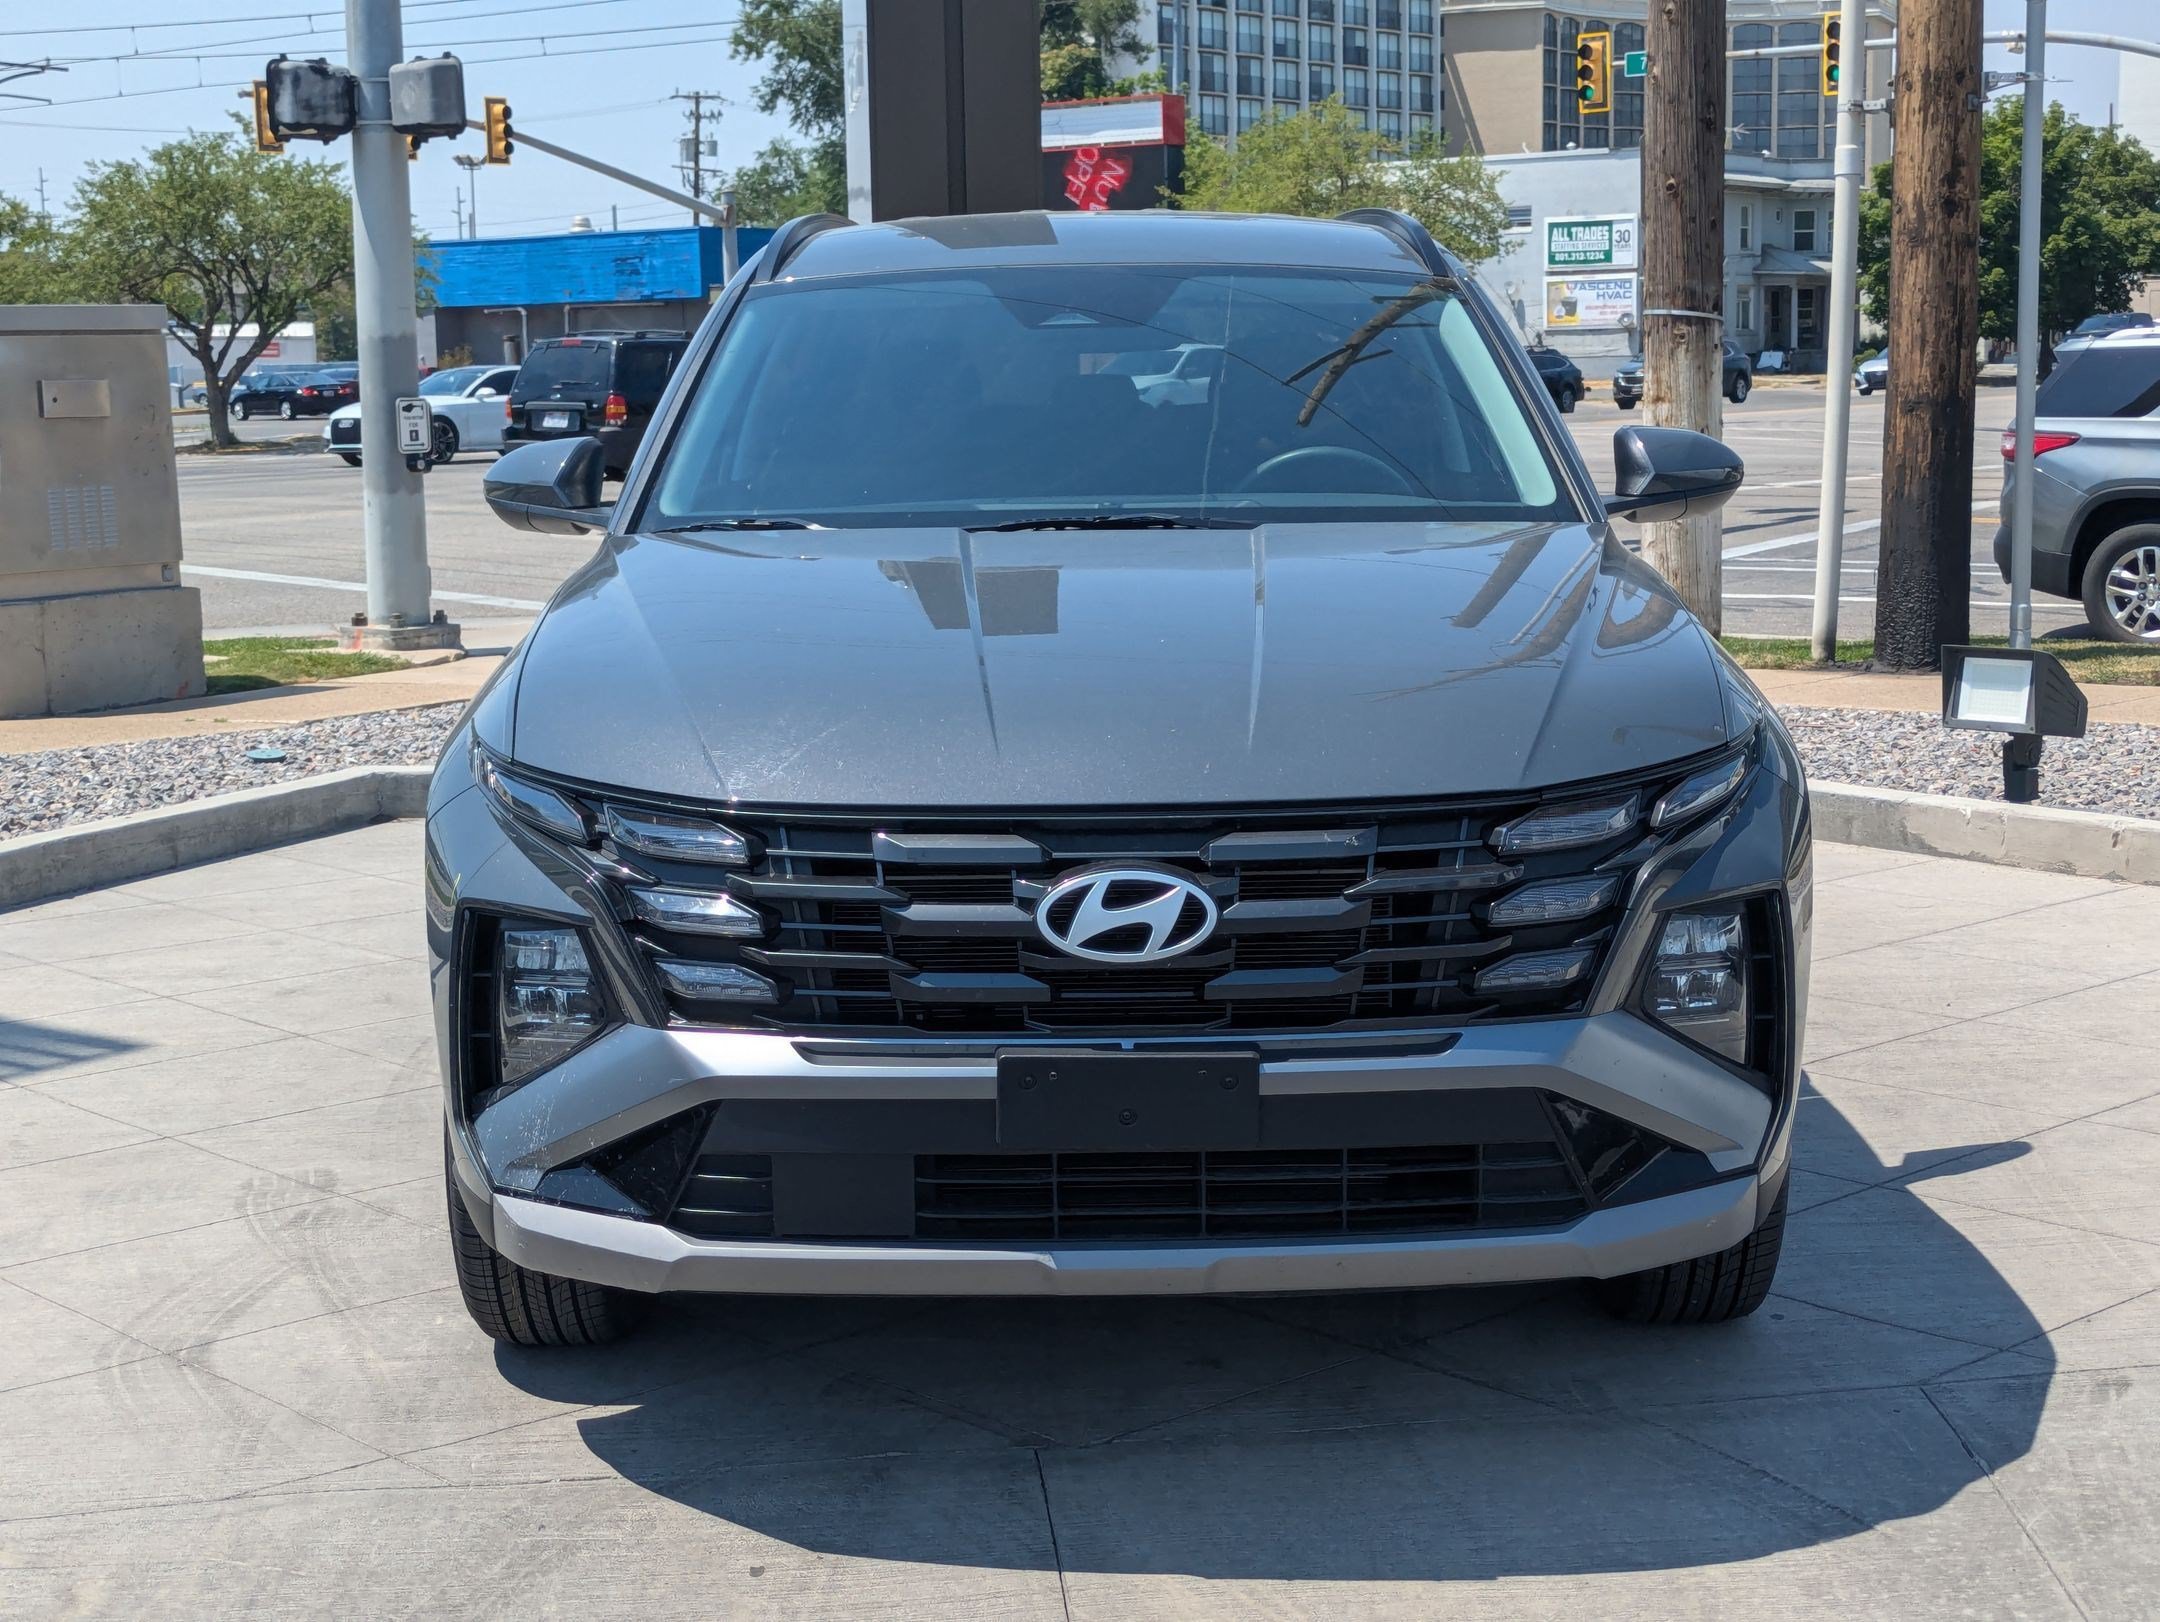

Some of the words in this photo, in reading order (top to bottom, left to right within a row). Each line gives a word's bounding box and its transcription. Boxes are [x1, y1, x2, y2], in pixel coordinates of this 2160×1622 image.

[1552, 227, 1570, 241] ALL
[1571, 225, 1609, 240] TRADES
[1615, 229, 1631, 243] 30
[1554, 242, 1580, 251] STAFFING
[1581, 241, 1607, 250] SERVICES
[1579, 281, 1632, 291] ASCEND
[1596, 291, 1632, 300] HVAC
